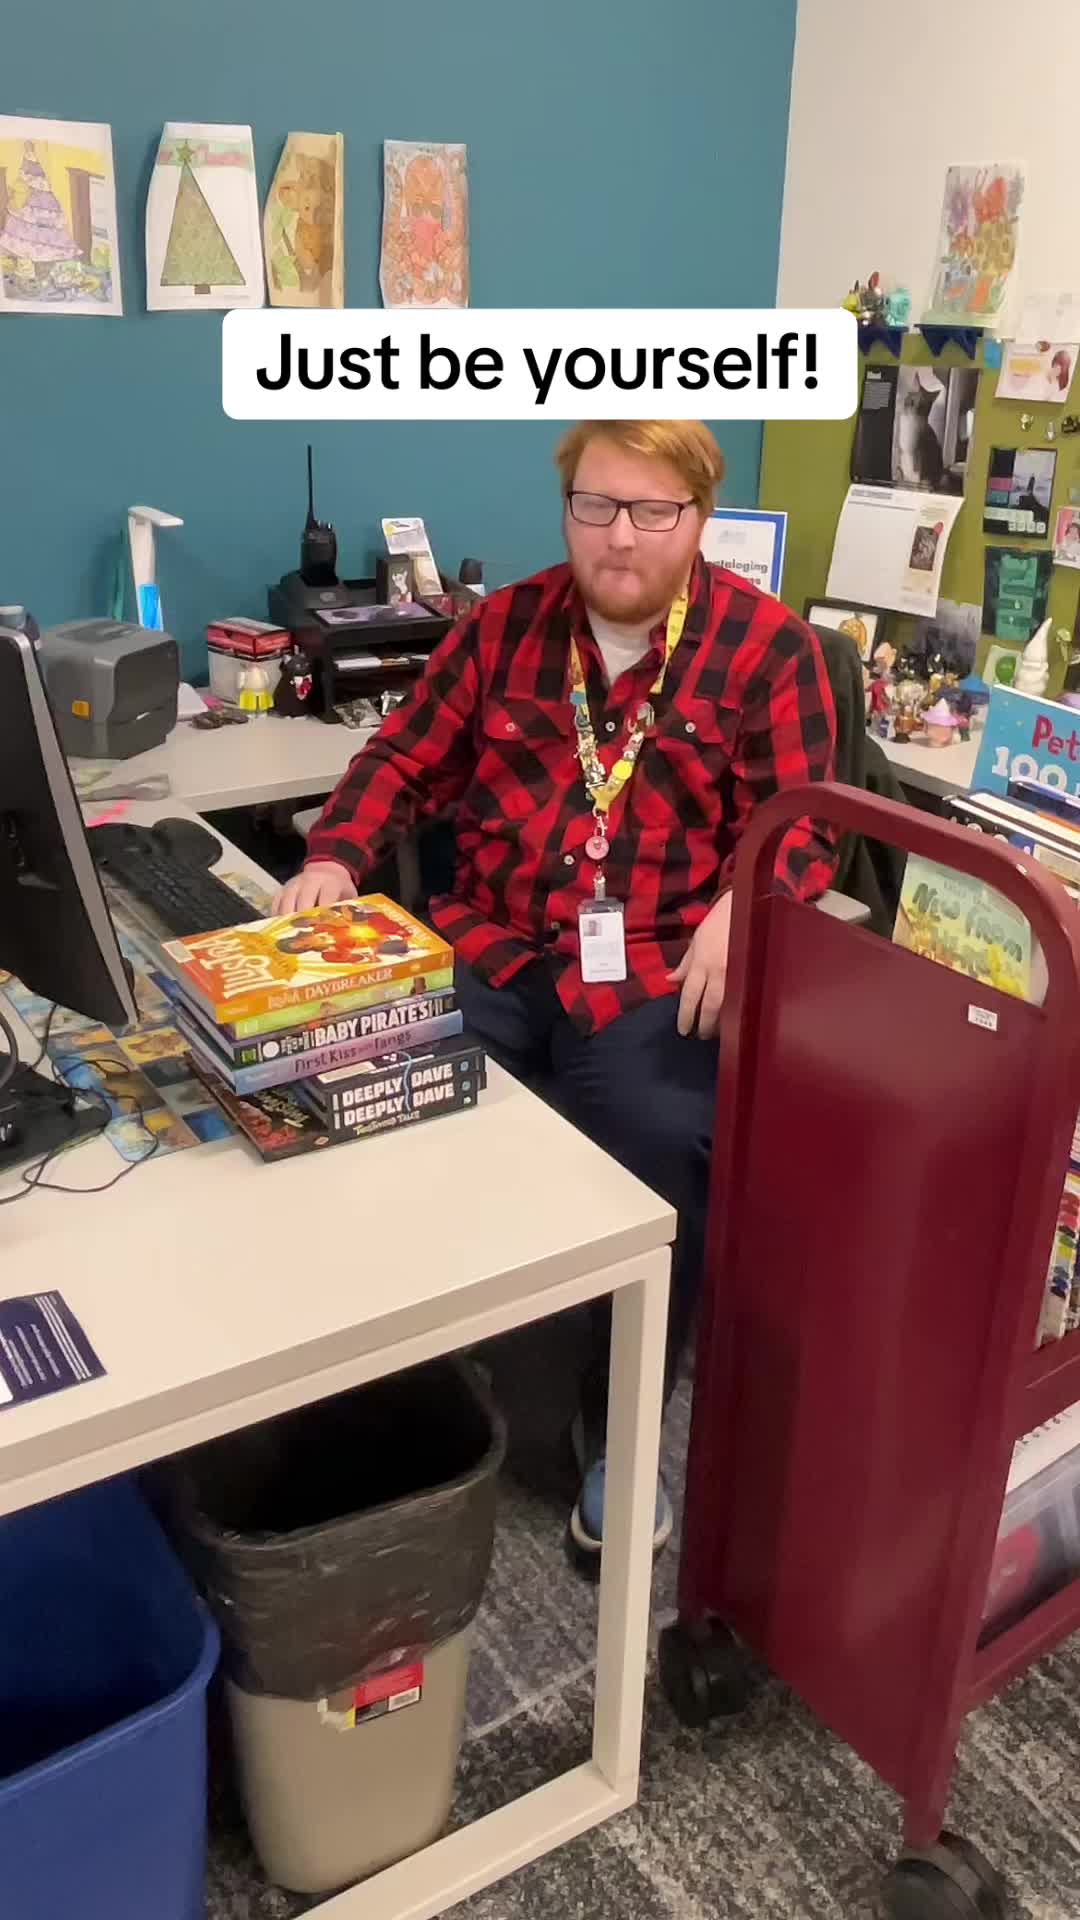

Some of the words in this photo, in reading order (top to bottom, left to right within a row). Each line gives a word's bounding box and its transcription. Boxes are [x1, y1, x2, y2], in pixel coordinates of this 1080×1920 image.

[709, 558, 769, 575] ataloging
[992, 746, 1067, 791] 100
[305, 968, 393, 1000] DAYBREAKER
[315, 1018, 358, 1047] BABY
[361, 1000, 428, 1034] PIRATES
[342, 1077, 403, 1107] DEEPLY
[411, 1063, 453, 1088] DAVE
[344, 1096, 404, 1127] DEEPLY
[413, 1083, 456, 1108] DAVE
